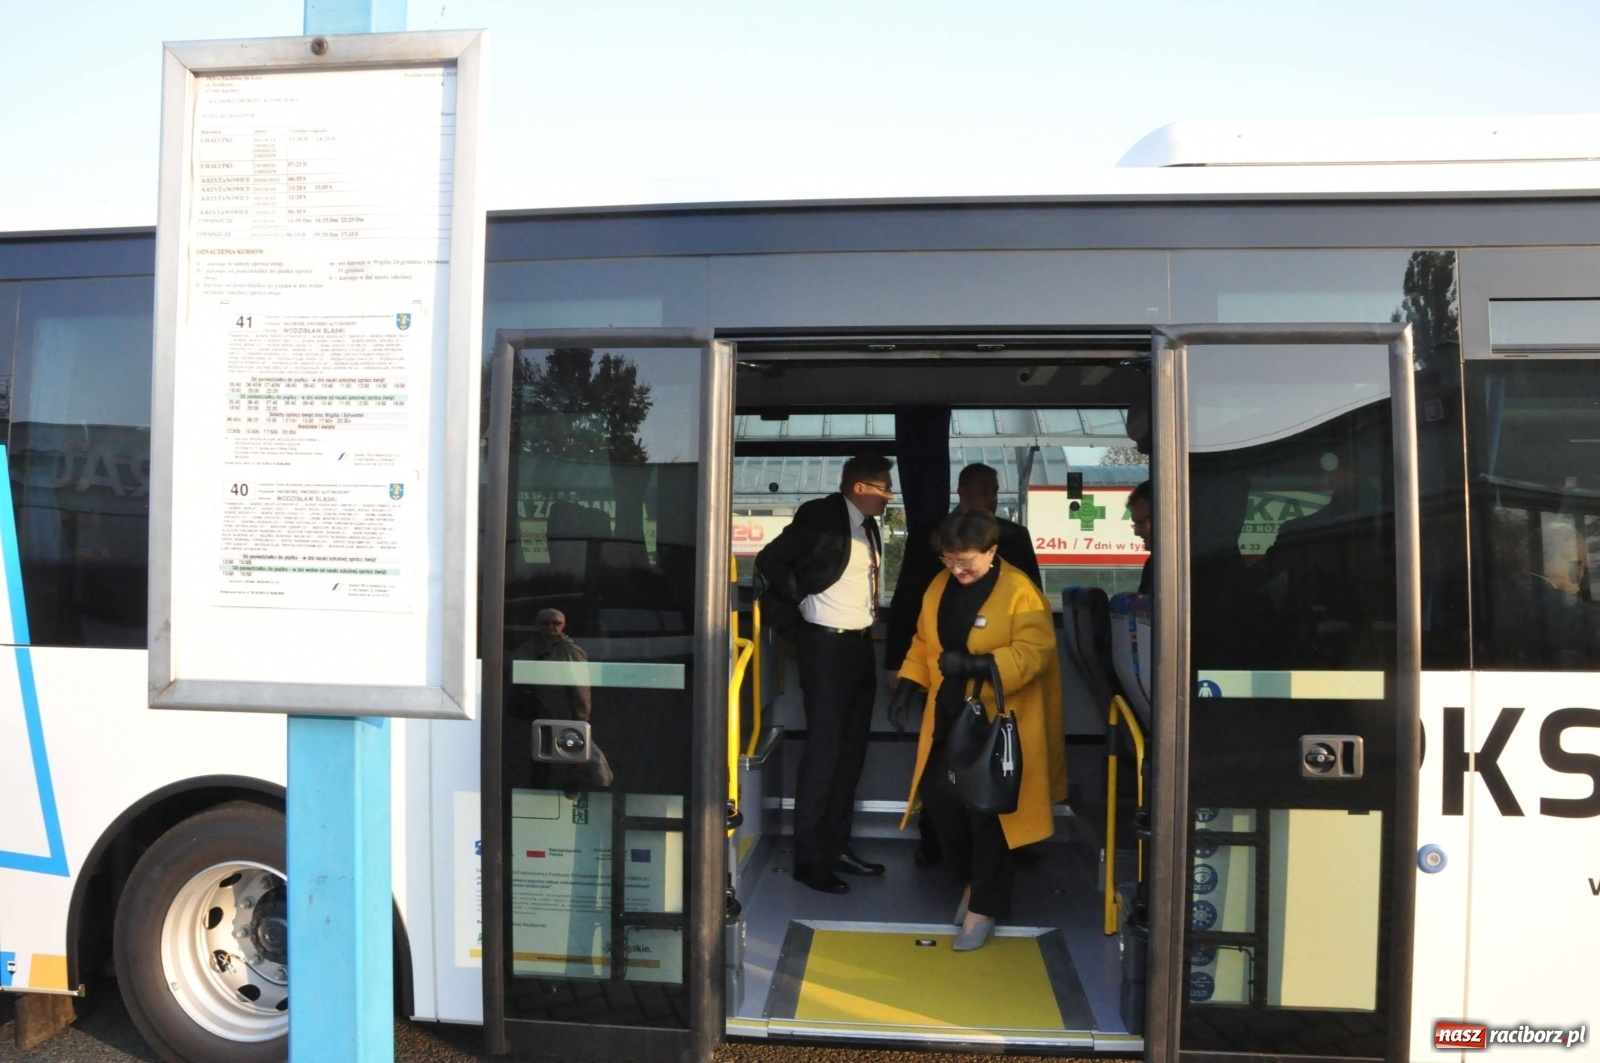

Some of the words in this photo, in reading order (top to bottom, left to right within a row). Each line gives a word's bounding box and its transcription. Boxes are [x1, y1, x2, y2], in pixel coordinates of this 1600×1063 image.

[236, 315, 252, 328] 41
[230, 483, 249, 497] 40
[315, 495, 338, 503] ŚLĄSKI
[1035, 537, 1067, 550] 24h
[1419, 707, 1600, 818] KS
